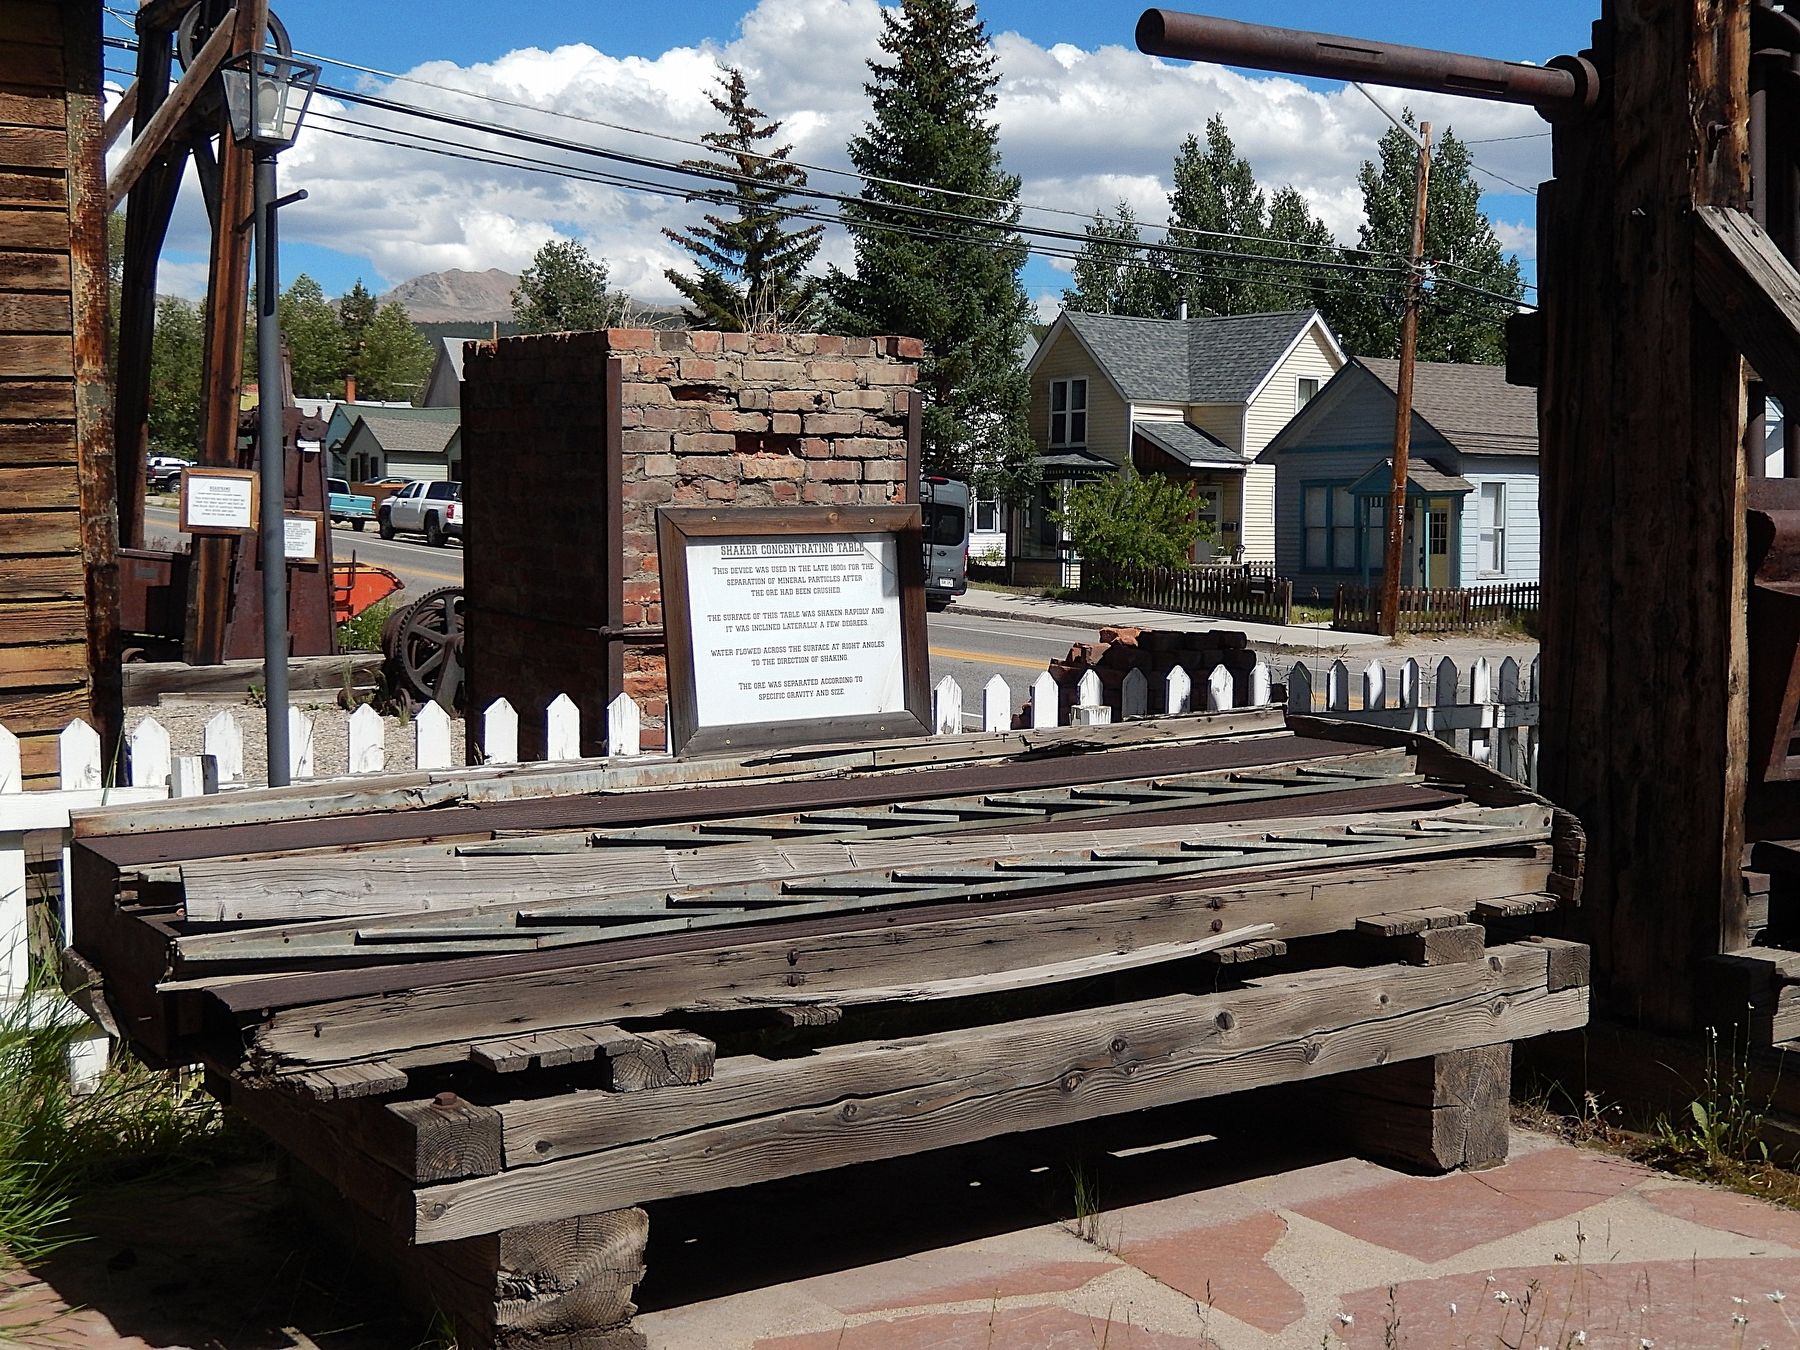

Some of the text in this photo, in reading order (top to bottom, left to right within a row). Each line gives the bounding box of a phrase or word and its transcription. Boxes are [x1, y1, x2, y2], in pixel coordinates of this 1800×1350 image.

[720, 546, 758, 556] SHAKER
[761, 544, 834, 555] CONCENTRATING
[712, 567, 729, 575] THIS
[788, 565, 796, 573] IN
[813, 564, 829, 572] LATE
[848, 563, 860, 571] FOR
[726, 578, 766, 586] SEPARATION
[767, 577, 775, 585] OF
[808, 575, 841, 583] PARTICLES
[750, 589, 764, 597] THE
[780, 588, 794, 596] HAD
[707, 614, 721, 622] THE
[723, 613, 751, 621] SURFACE
[752, 612, 761, 620] OF
[780, 611, 800, 619] TABLE
[817, 609, 843, 617] SHAKEN
[871, 607, 884, 615] AND
[726, 625, 733, 633] IT
[751, 623, 781, 631] INCLINED
[782, 622, 818, 630] LATERALLY
[826, 620, 840, 628] FEW
[710, 649, 734, 657] WATER
[735, 647, 761, 655] FLOWED
[763, 646, 787, 654] ACROSS
[788, 645, 802, 653] THE
[803, 644, 830, 652] SURFACE
[841, 642, 861, 650] RIGHT
[762, 658, 775, 666] THE
[777, 656, 809, 665] DIRECTION
[811, 655, 819, 663] OF
[738, 682, 752, 690] THE
[783, 679, 819, 687] SEPARATED
[820, 676, 853, 685] ACCORDING
[854, 675, 863, 683] TO
[758, 692, 785, 701] SPECIFIC
[786, 690, 814, 699] GRAVITY
[816, 689, 829, 697] AND
